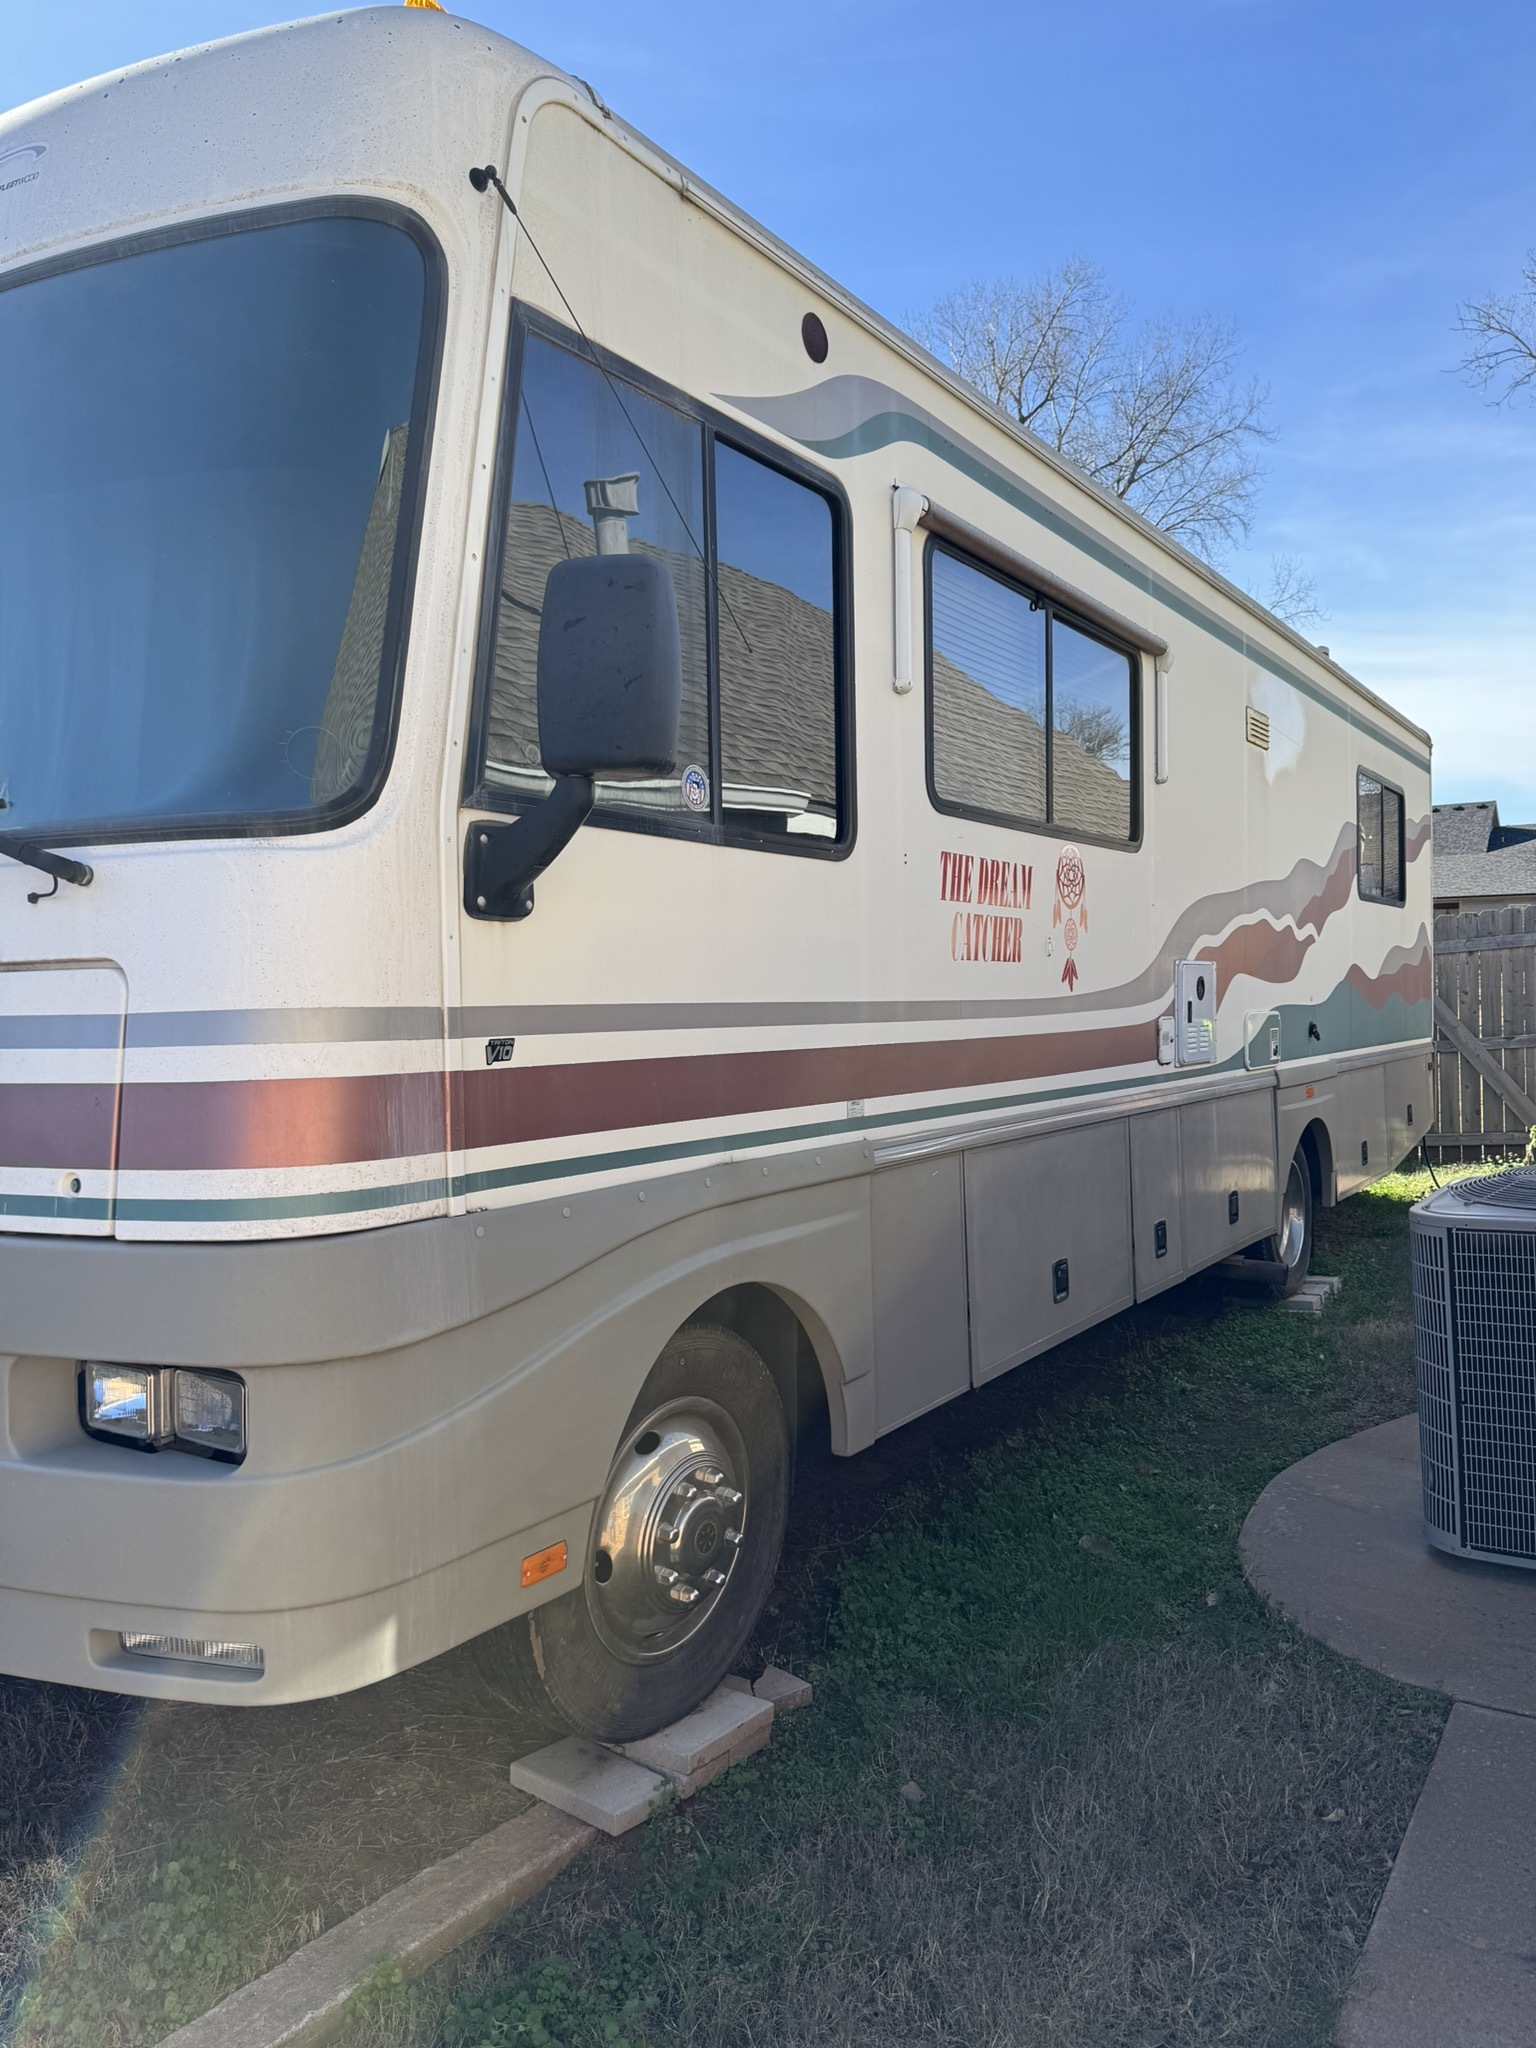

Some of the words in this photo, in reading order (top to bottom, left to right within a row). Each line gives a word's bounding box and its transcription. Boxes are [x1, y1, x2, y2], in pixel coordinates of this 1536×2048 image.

[940, 850, 974, 903] THE
[977, 856, 1033, 910] DREAM
[951, 911, 1023, 963] CATCHER
[486, 1045, 513, 1064] V10
